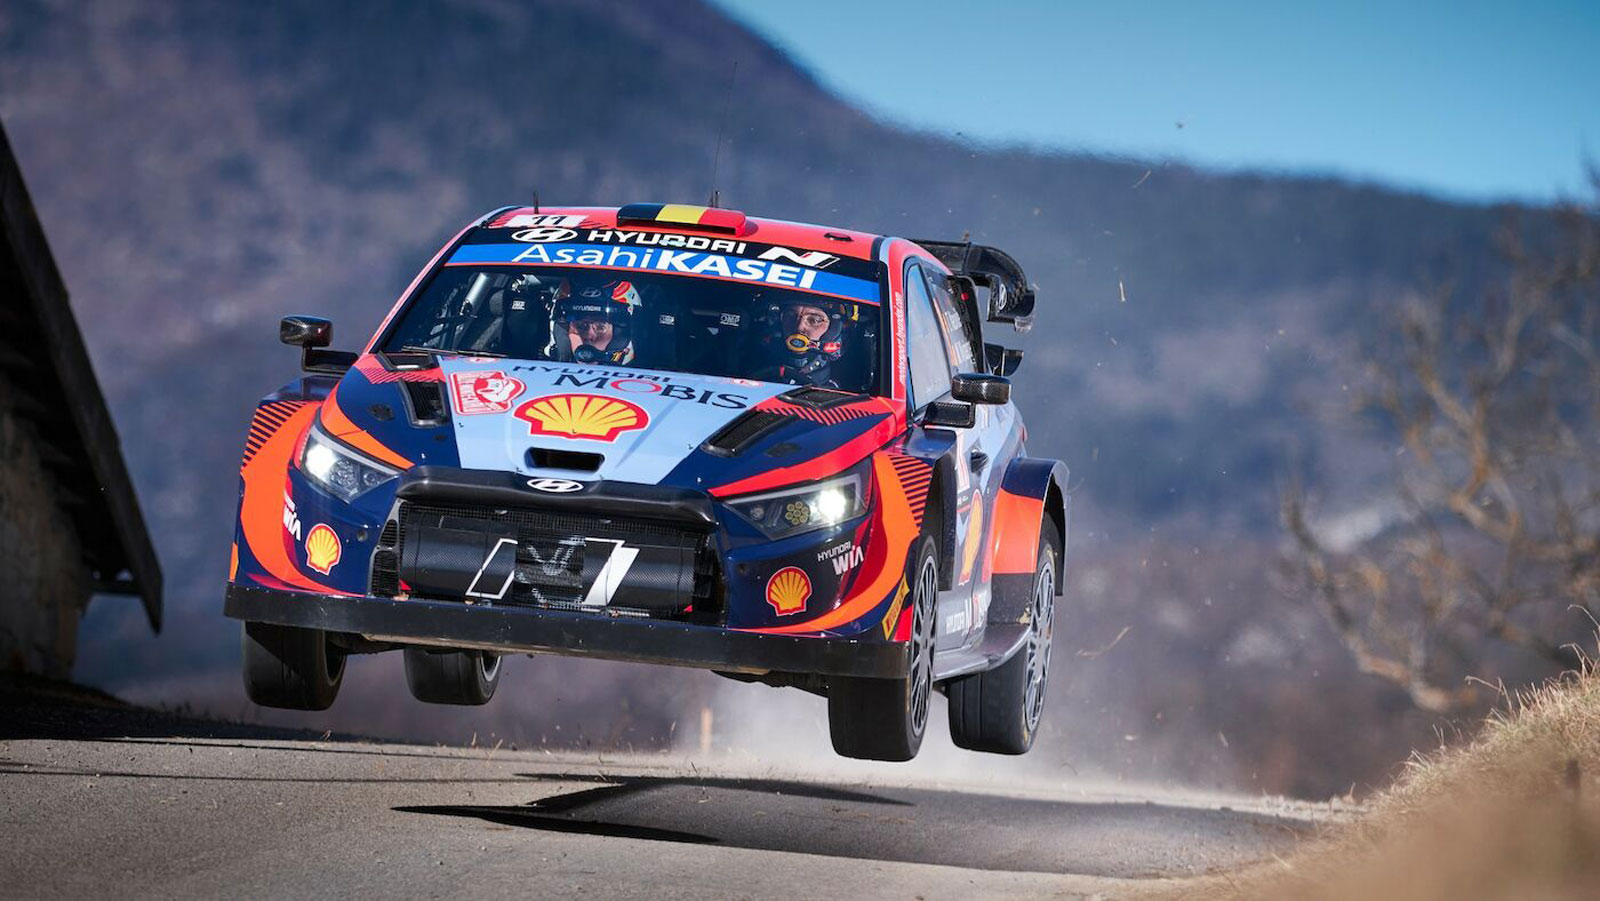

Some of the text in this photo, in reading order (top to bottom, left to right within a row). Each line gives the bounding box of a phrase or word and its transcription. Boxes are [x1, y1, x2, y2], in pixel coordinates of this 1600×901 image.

[532, 215, 568, 226] 11
[587, 230, 747, 255] HYUNDAI
[512, 365, 671, 383] HYUNDAI
[552, 374, 749, 410] MOBIS
[817, 541, 851, 562] HYUNDAI
